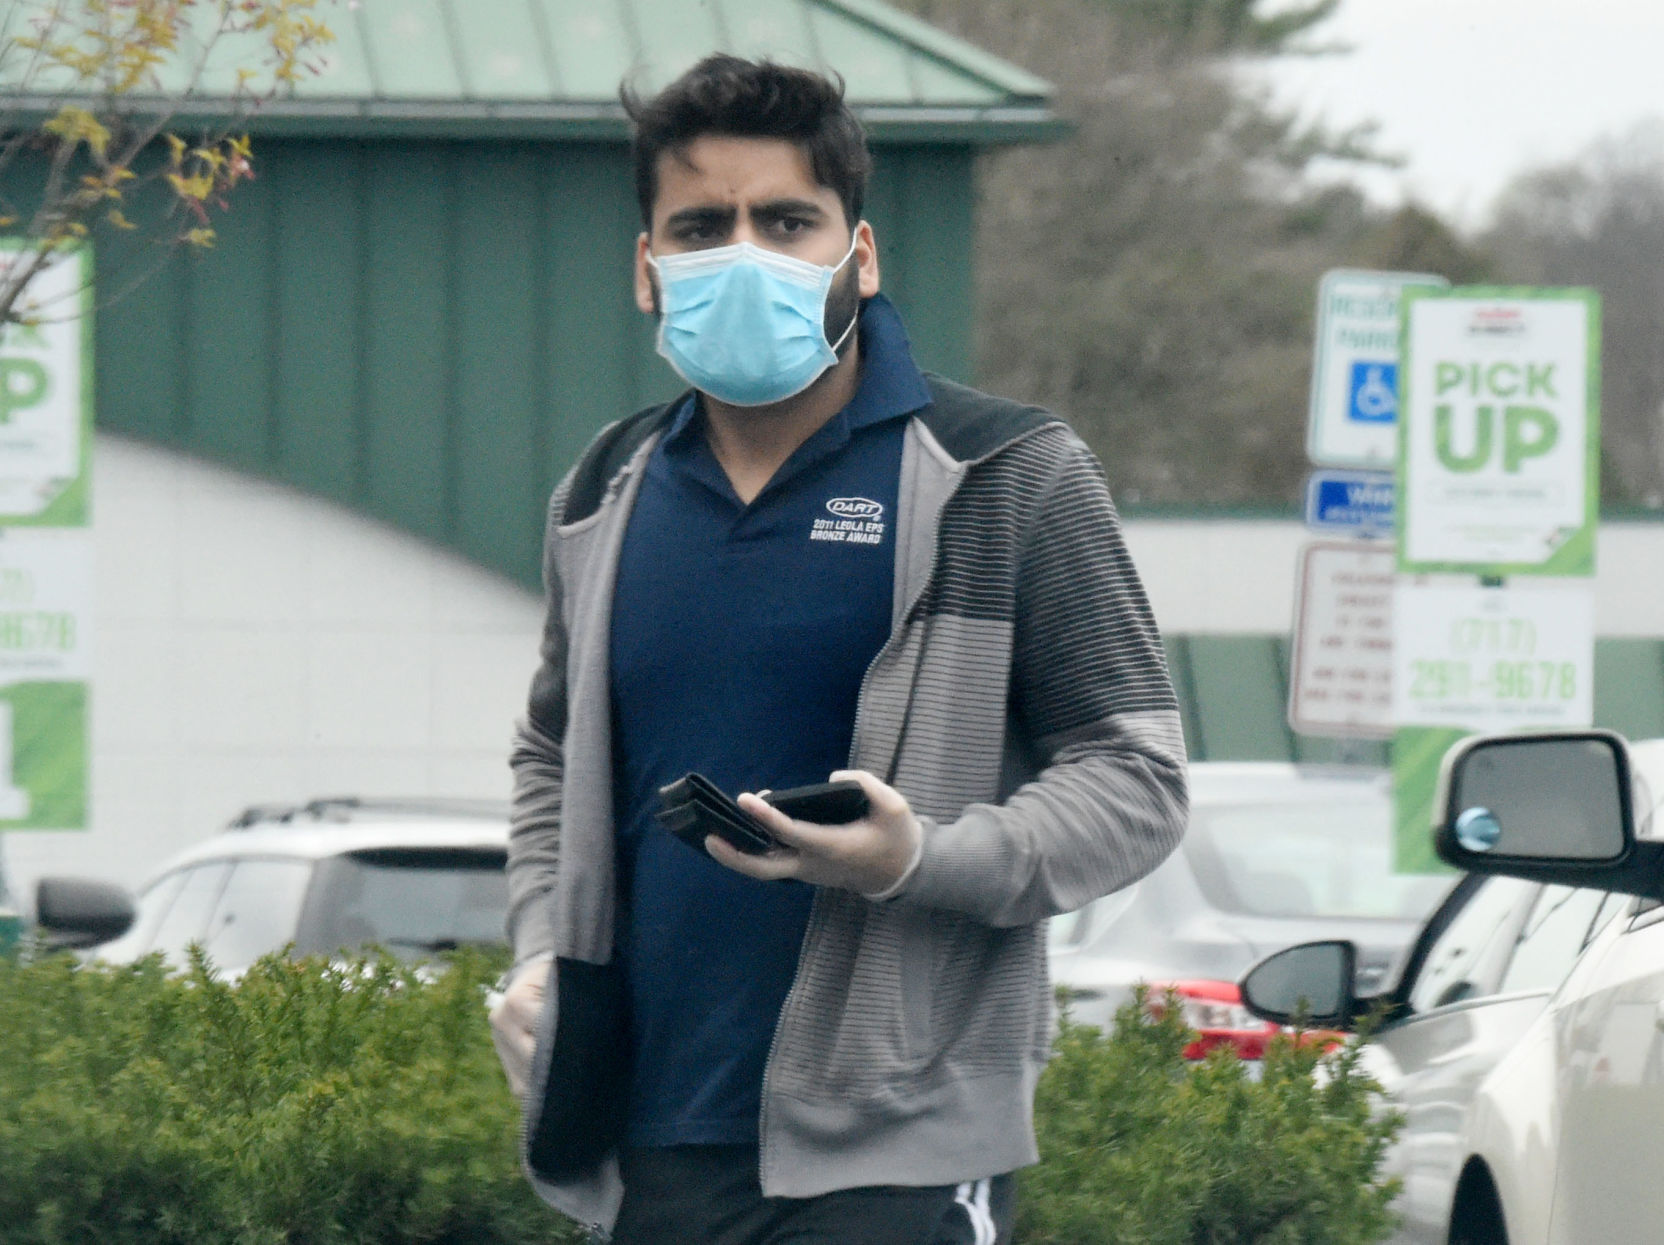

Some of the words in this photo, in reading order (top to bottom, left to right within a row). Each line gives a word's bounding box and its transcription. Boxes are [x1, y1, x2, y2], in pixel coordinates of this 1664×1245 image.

[1433, 361, 1560, 398] PICK
[1433, 404, 1561, 474] UP
[831, 501, 879, 514] DART
[810, 529, 846, 541] BRONZE
[846, 531, 881, 544] AWARD
[813, 518, 834, 530] 2011
[835, 520, 864, 532] LEOLA
[865, 522, 885, 534] EPS
[1408, 658, 1578, 701] 291-9678
